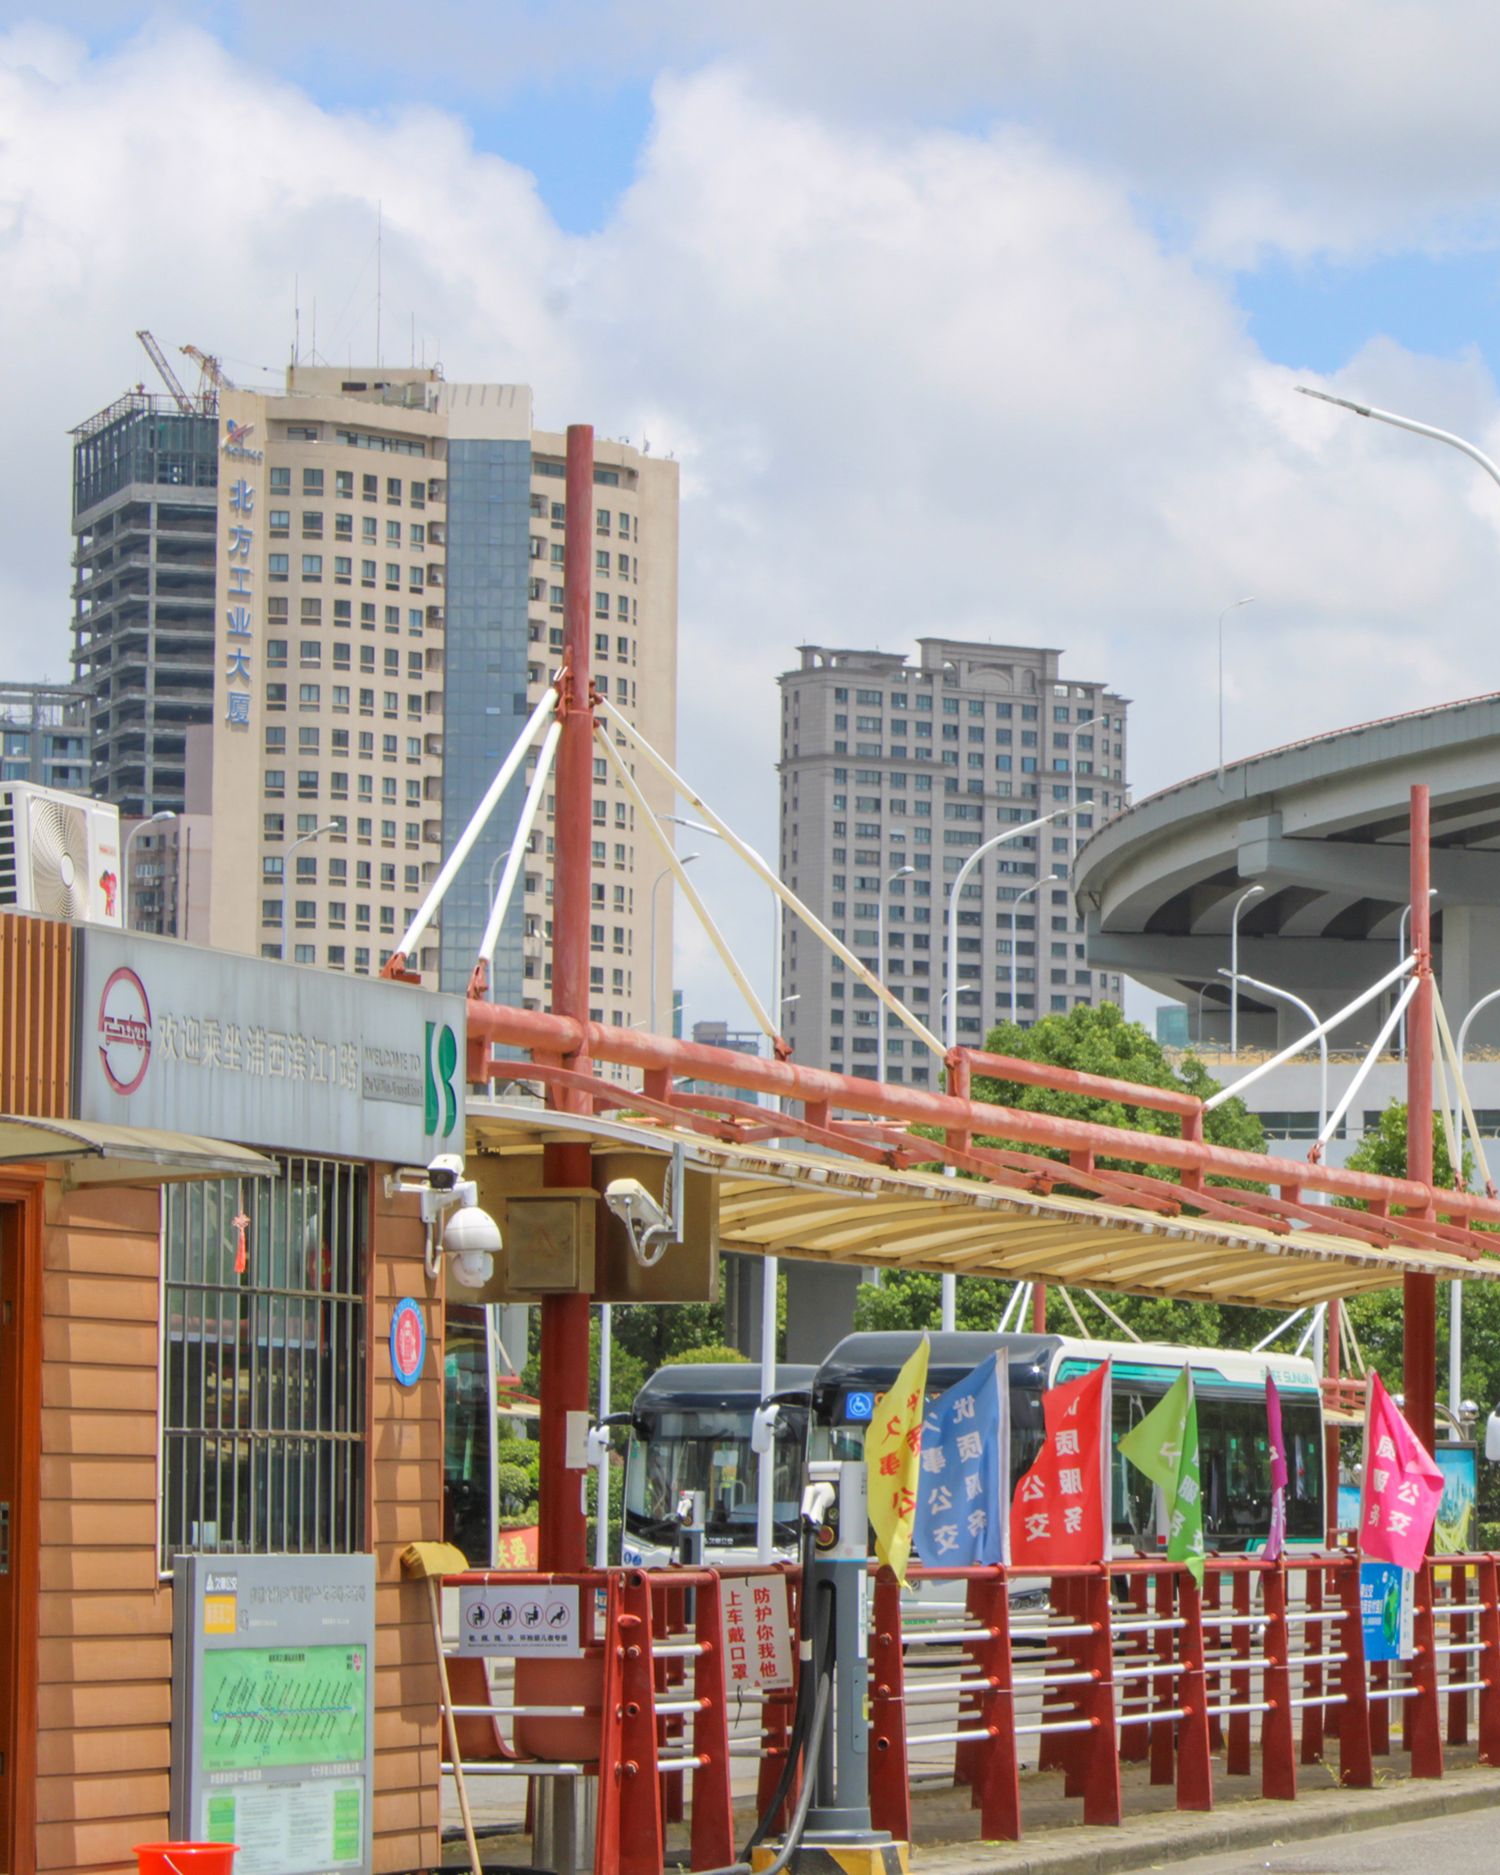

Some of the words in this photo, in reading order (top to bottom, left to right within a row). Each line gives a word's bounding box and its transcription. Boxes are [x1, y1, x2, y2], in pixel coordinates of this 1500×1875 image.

[225, 479, 254, 725] 北方工业大厦
[157, 1014, 357, 1090] 欢迎乘坐浦西滨江1路
[365, 1046, 407, 1070] WELCOME
[725, 1590, 749, 1681] 上车戴口罩
[753, 1588, 778, 1679] 防护你我他
